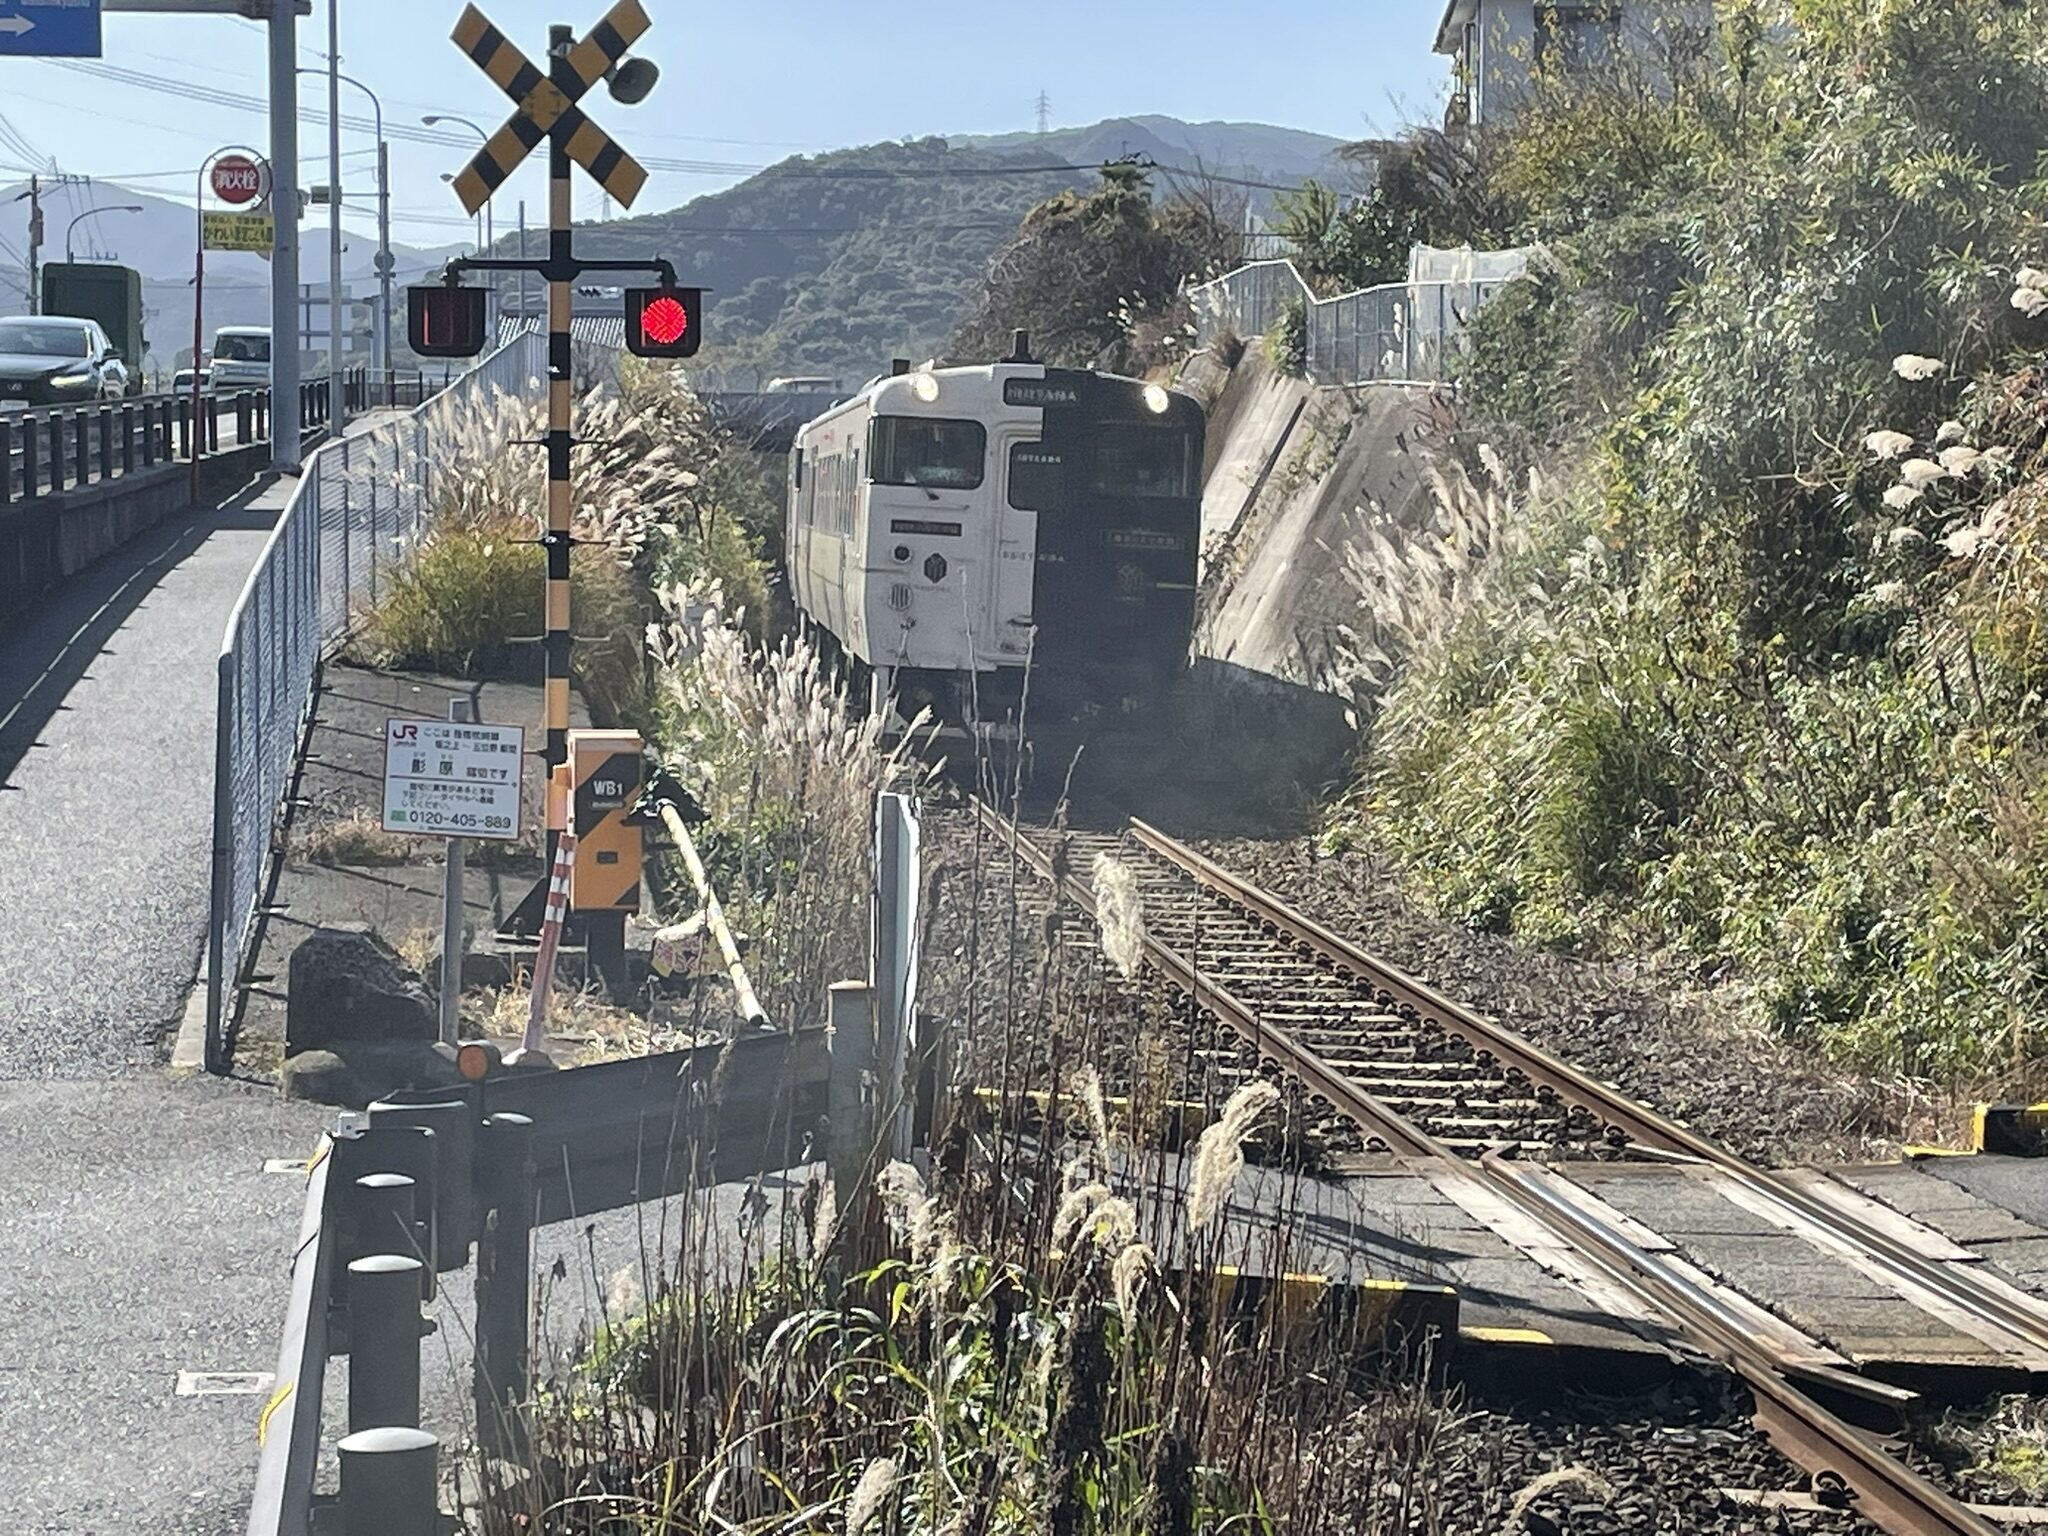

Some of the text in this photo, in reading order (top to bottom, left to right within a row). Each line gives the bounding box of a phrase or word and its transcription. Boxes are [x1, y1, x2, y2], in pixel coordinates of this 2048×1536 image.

[215, 169, 258, 190] 消火栓
[393, 725, 418, 740] JR
[593, 780, 623, 796] WB1
